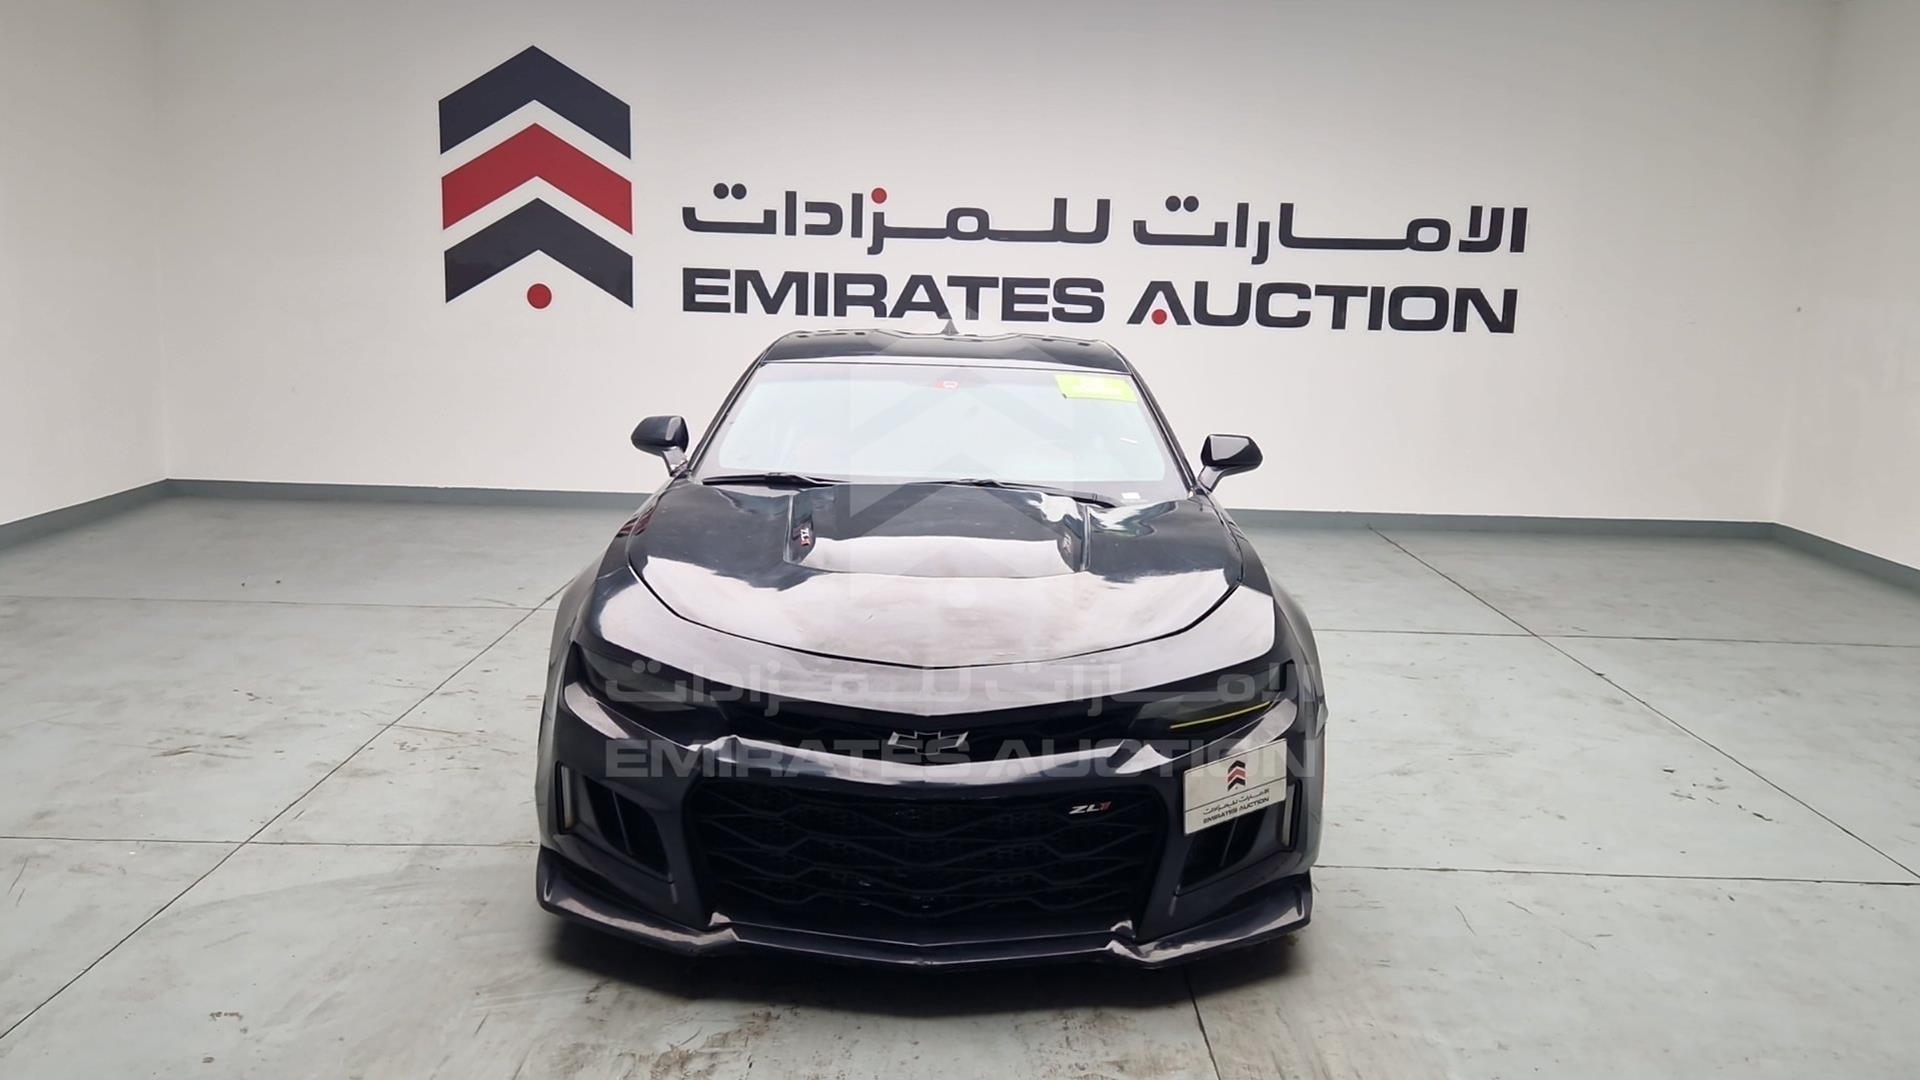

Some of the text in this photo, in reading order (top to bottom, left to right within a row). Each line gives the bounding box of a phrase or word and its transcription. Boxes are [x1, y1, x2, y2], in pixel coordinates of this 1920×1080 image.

[682, 183, 1527, 265] الامارات للمزادات
[682, 267, 1519, 334] EMIRATES AUCTION
[1069, 801, 1111, 815] ZL1
[1202, 796, 1270, 825] EMIRATES AUCTION
